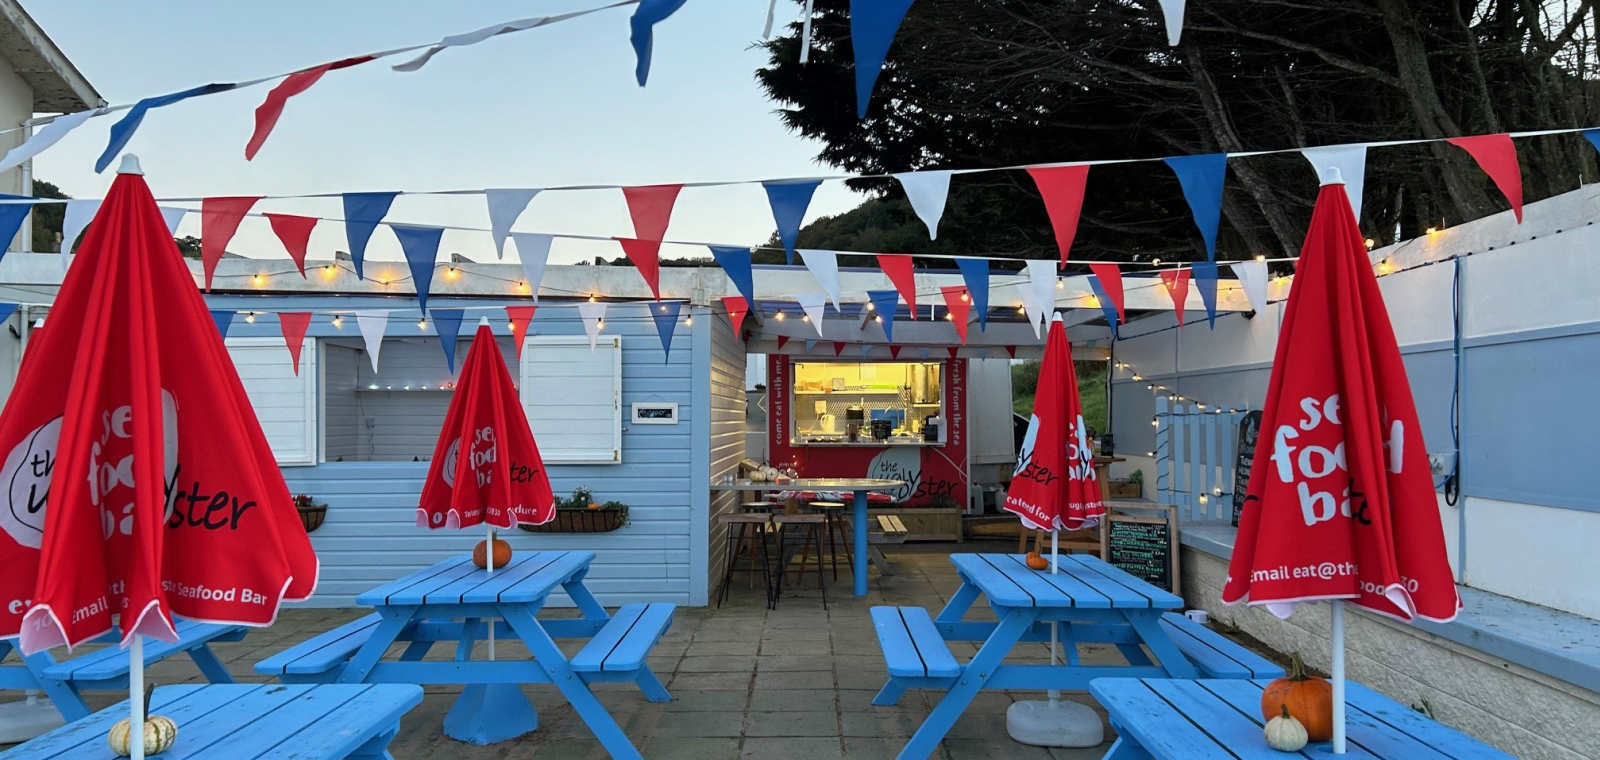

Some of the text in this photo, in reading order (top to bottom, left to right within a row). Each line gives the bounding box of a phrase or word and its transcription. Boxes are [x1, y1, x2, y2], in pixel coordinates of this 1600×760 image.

[952, 386, 963, 411] from
[1299, 393, 1343, 432] se
[30, 448, 57, 478] th
[510, 461, 540, 484] ter
[880, 459, 898, 473] the
[163, 463, 259, 531] yster
[1035, 506, 1051, 522] for
[178, 584, 237, 603] Seafood
[240, 588, 268, 606] Bar
